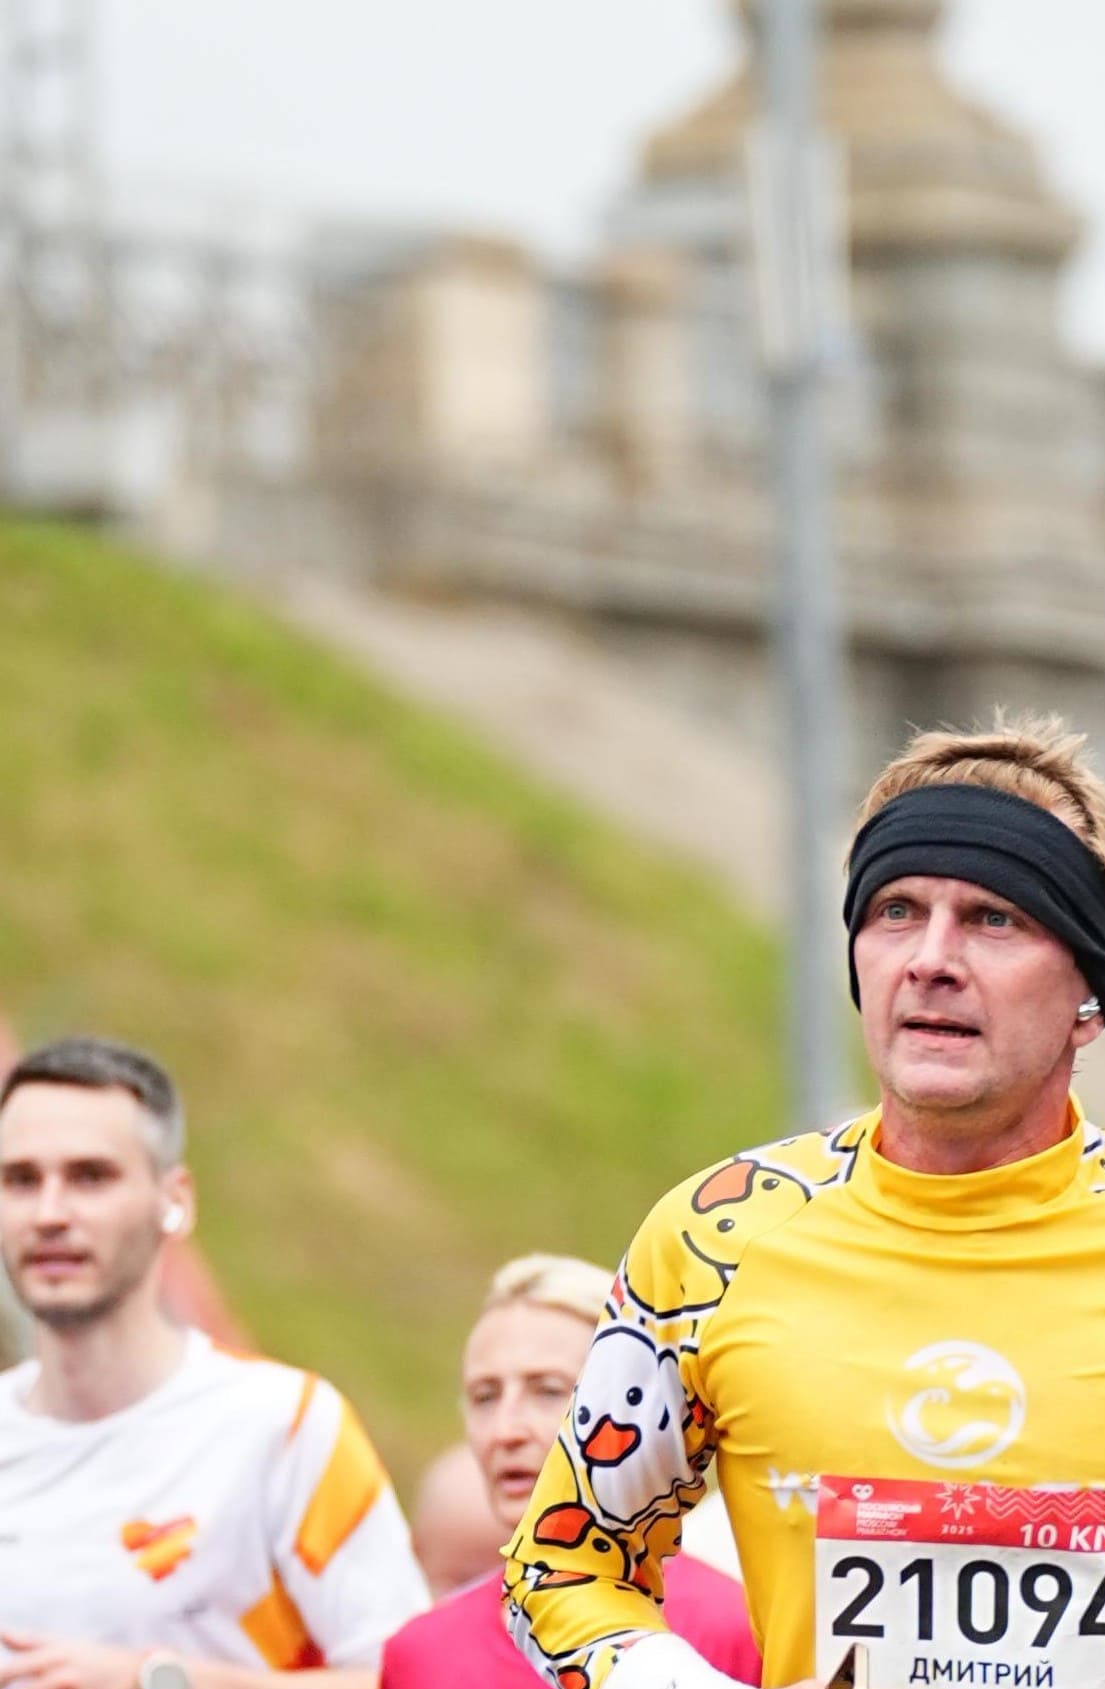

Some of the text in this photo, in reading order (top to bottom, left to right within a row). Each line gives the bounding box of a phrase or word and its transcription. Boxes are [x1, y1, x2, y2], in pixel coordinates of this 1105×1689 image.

[940, 1523, 976, 1536] 2025
[1020, 1523, 1058, 1549] 10
[908, 1656, 1055, 1689] ДМИТРИЙ
